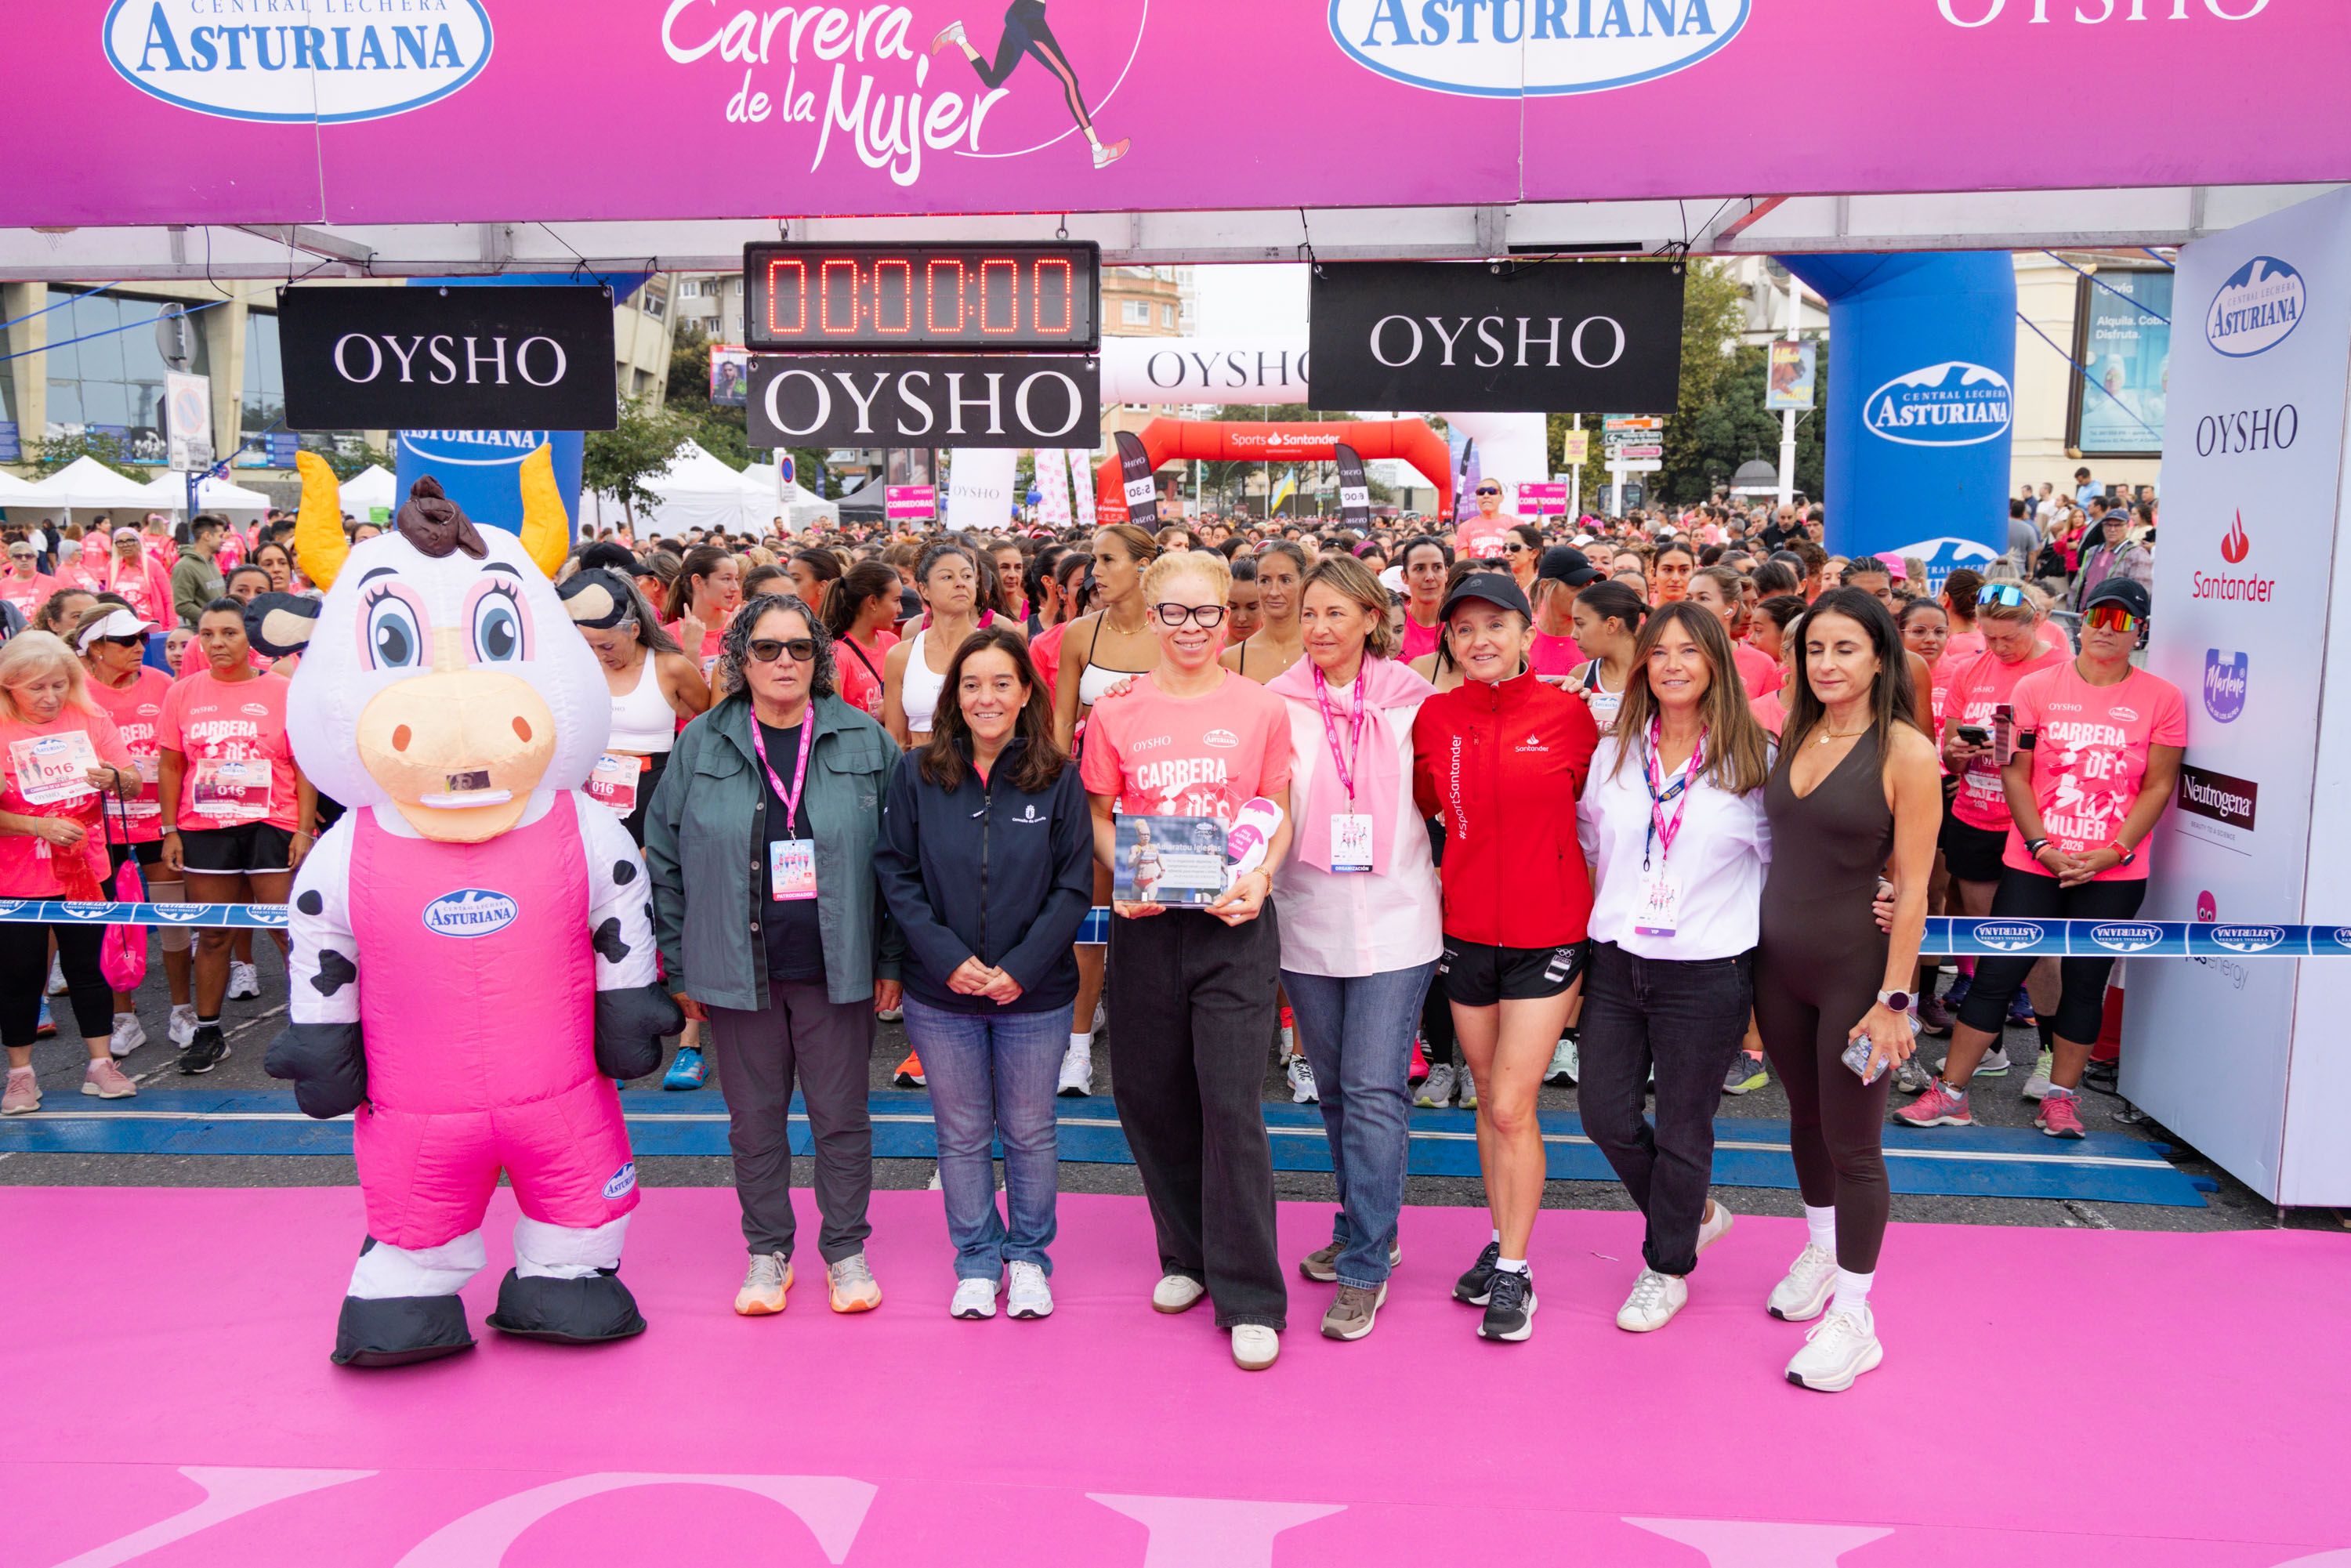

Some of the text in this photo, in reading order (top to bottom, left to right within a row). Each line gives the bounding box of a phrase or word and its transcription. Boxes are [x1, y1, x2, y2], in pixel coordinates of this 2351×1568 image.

[661, 0, 914, 64] Carrera
[1360, 0, 1717, 47] ASTURIANA
[136, 0, 465, 72] ASTURIANA
[725, 53, 1010, 187] de la Mujer
[768, 259, 1071, 334] 00:00:00
[2227, 281, 2296, 307] CENTRAL LECHERA
[2096, 316, 2136, 328] Alquila.
[2211, 295, 2298, 339] ASTURIANA
[1370, 314, 1626, 368] OYSHO
[2096, 329, 2141, 340] Disfruta.
[334, 332, 568, 387] OYSHO
[764, 369, 1083, 437] OYSHO
[1903, 390, 1961, 402] CENTRAL
[1874, 395, 2008, 427] ASTURIANA
[1231, 433, 1341, 447] Sports Santander
[2197, 404, 2298, 457] OYSHO
[953, 486, 1000, 500] OYSHO
[887, 499, 934, 509] CORREDORAS
[2192, 570, 2276, 603] Santander
[2206, 664, 2244, 701] Marlene
[190, 705, 218, 715] OYSHO
[2048, 703, 2082, 712] OYSHO
[190, 719, 258, 740] CARRERA
[2048, 721, 2127, 748] CARRERA
[1133, 735, 1172, 752] OYSHO
[44, 762, 74, 777] 016
[1138, 757, 1227, 791] CARRERA
[217, 785, 246, 795] 016
[592, 781, 614, 795] 016
[2183, 773, 2251, 817] Neutrogena
[2043, 813, 2107, 841] MUJER
[1157, 842, 1222, 853] Adiaratou Iglesias
[2060, 838, 2085, 852] 2026
[431, 907, 512, 925] ASTURIANA
[1979, 927, 2040, 940] ASTURIANA
[2096, 928, 2157, 941] ASTURIANA
[2217, 929, 2281, 941] ASTURIANA
